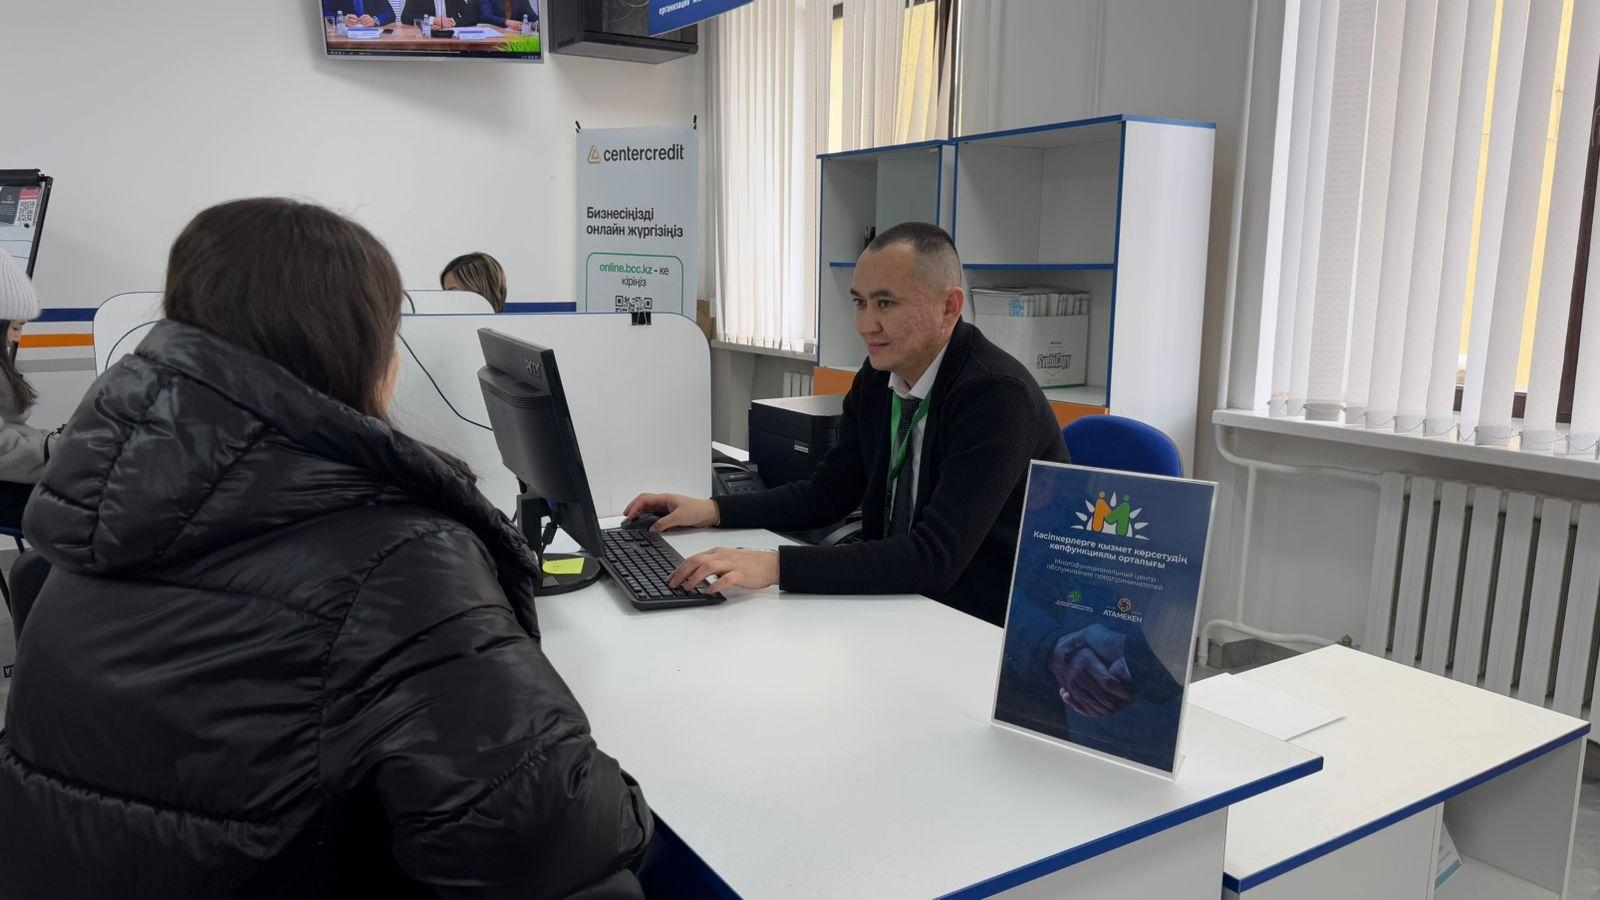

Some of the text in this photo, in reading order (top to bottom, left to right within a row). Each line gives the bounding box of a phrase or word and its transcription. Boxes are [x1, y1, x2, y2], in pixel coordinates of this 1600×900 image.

[603, 144, 684, 162] centercredit
[586, 206, 654, 222] Бизнесіңізді
[586, 223, 684, 239] онлайн жүргізіңіз
[599, 262, 653, 275] online.bcc.kz
[621, 276, 647, 288] кіріңіз
[1098, 543, 1132, 555] қызмет
[1118, 554, 1166, 570] орталығы
[1103, 609, 1143, 623] АТАМЕКЕН
